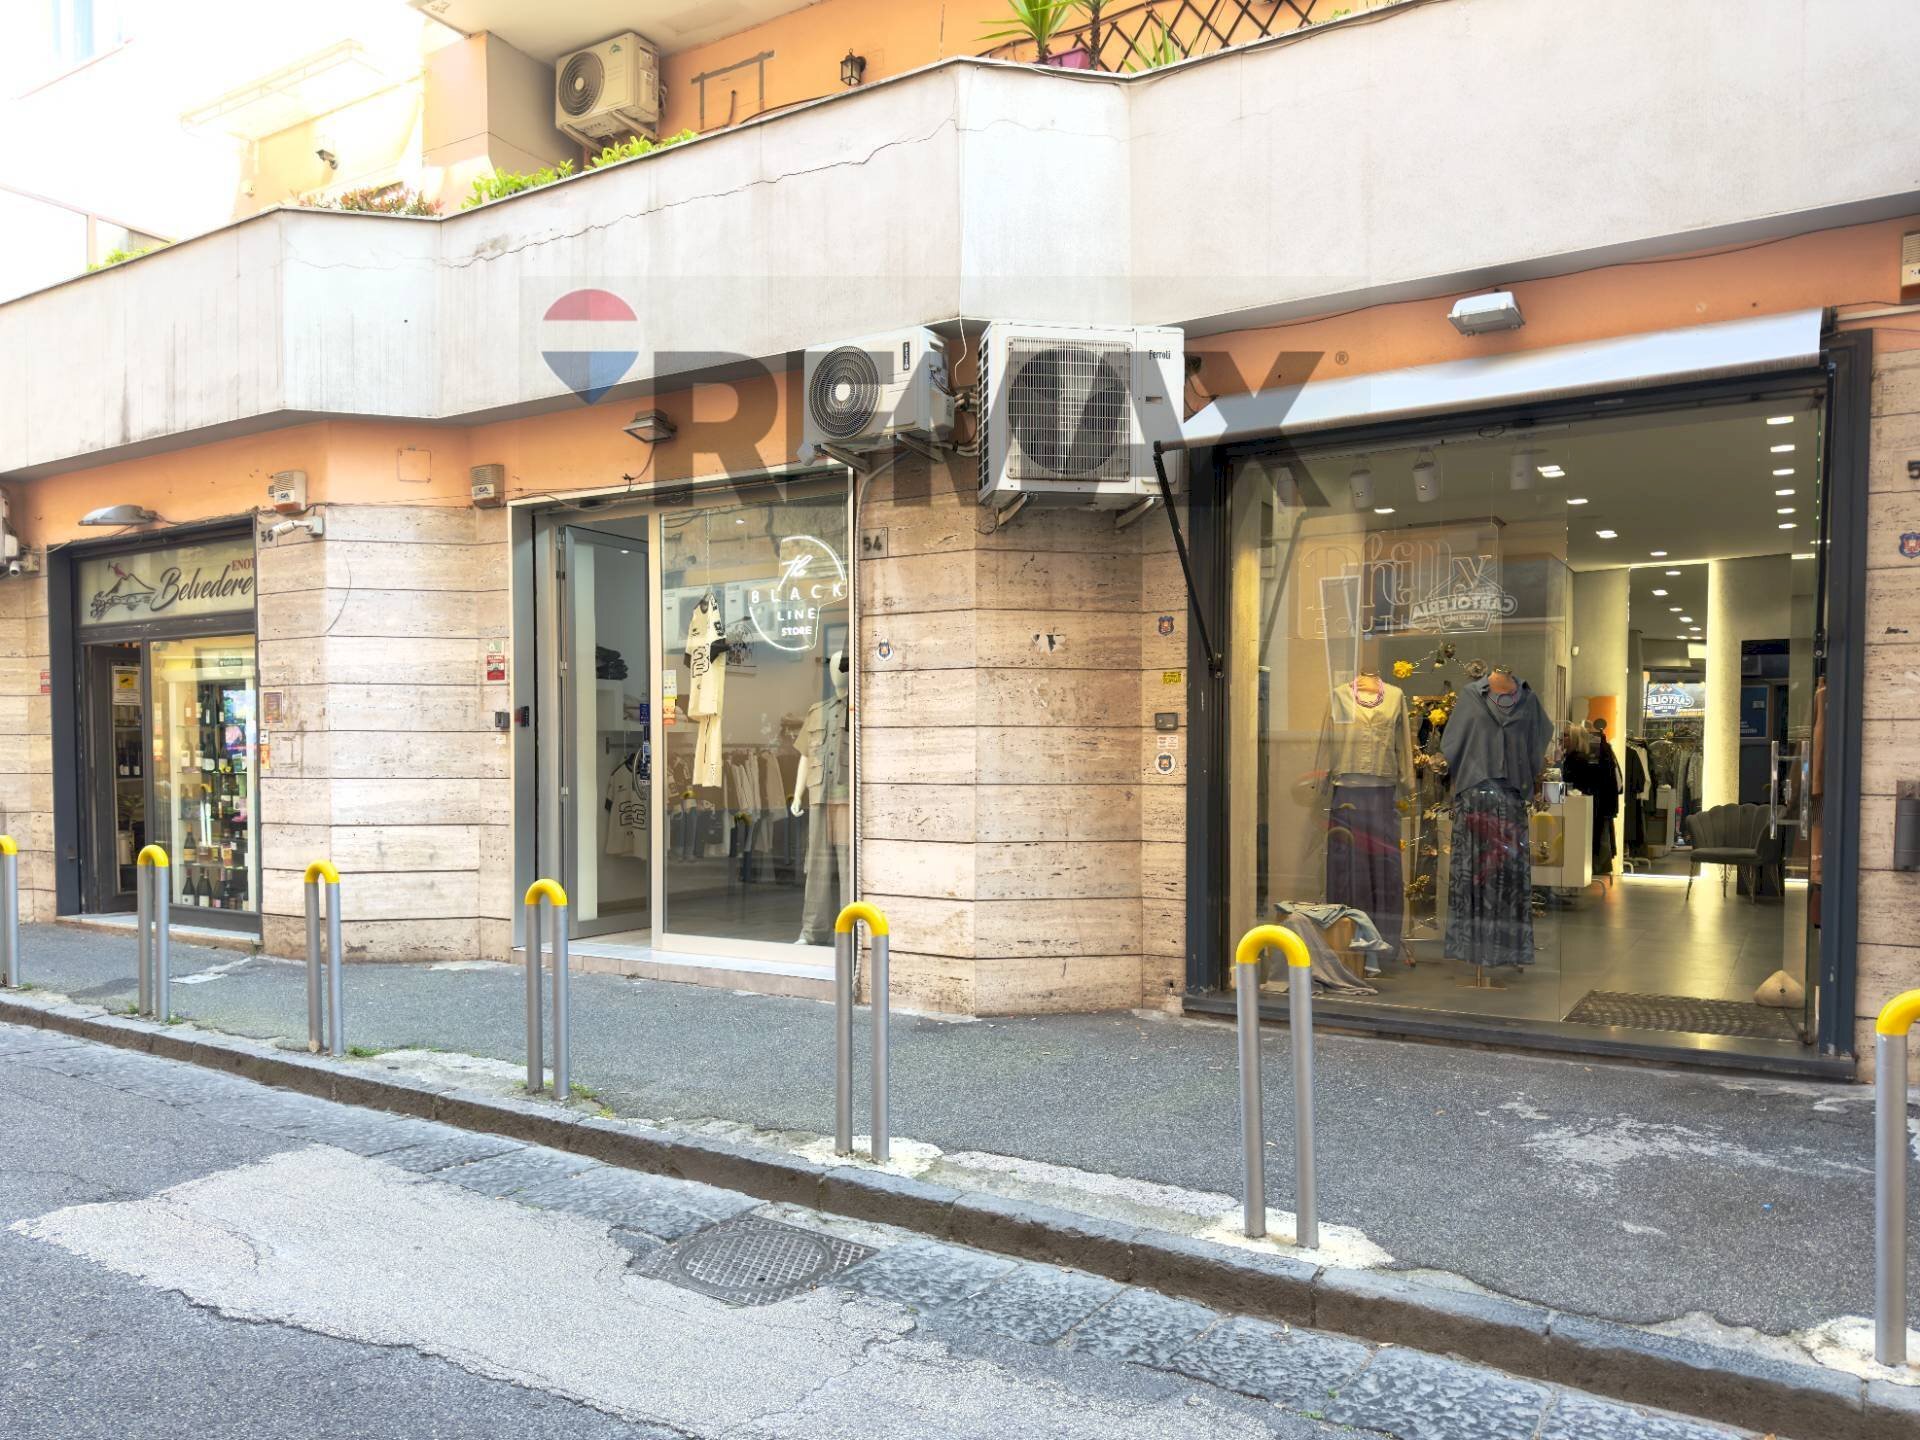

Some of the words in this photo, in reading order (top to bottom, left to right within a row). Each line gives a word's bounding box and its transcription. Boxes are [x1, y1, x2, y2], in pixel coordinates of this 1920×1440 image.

[261, 530, 274, 543] 56
[863, 536, 882, 552] 54
[150, 565, 254, 612] Belvedere
[751, 582, 844, 604] BLACK
[777, 607, 817, 621] LINE
[781, 625, 813, 637] STORE
